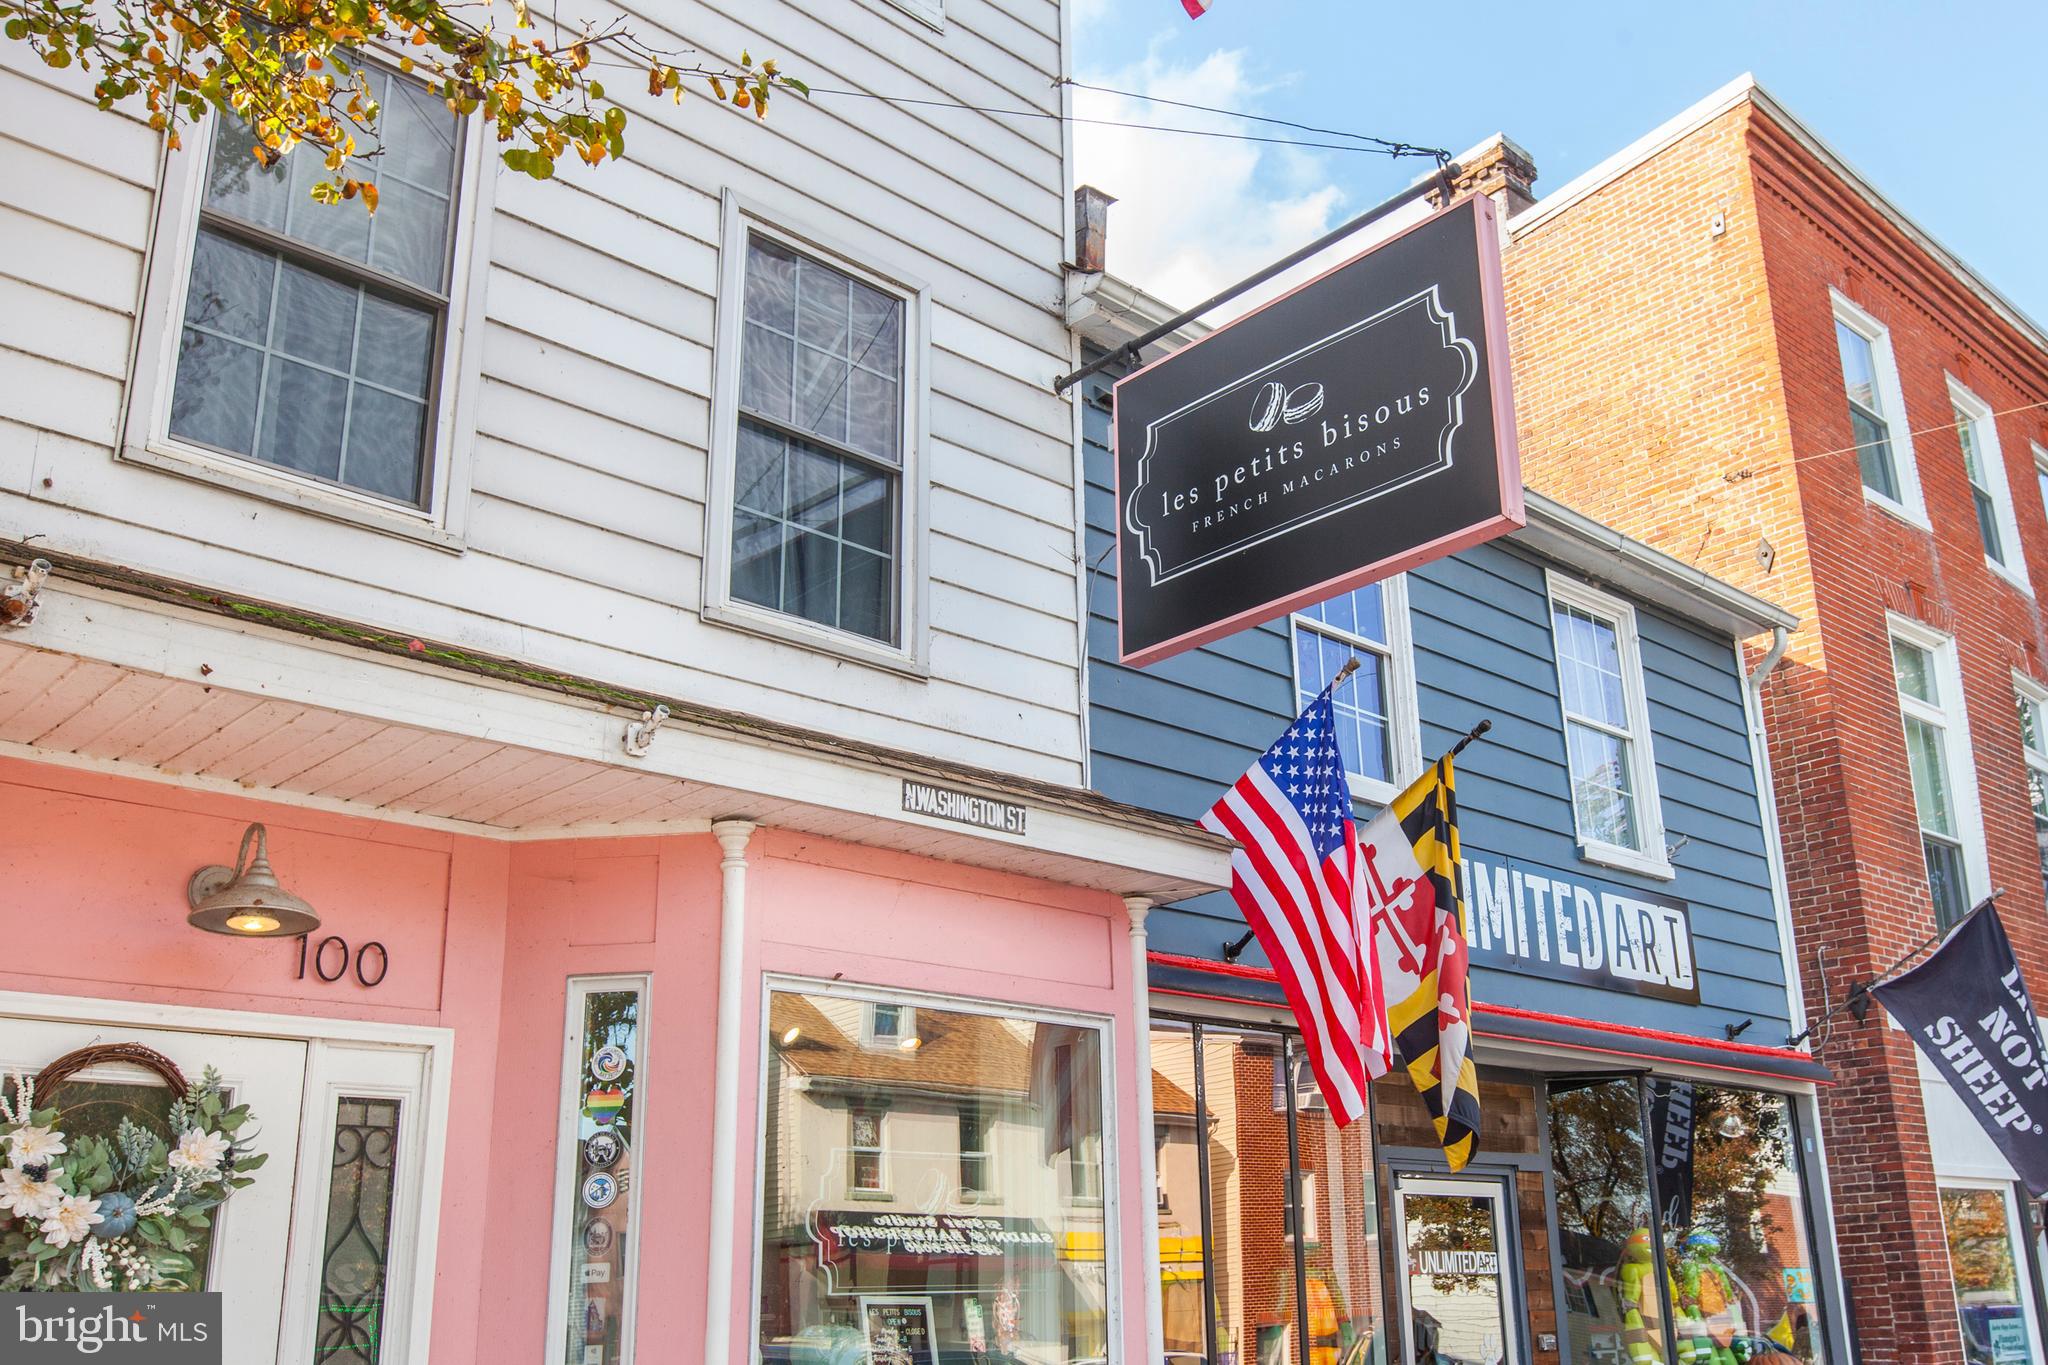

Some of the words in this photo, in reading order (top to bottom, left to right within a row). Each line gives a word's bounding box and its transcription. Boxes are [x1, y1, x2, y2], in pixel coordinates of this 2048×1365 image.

[1161, 487, 1199, 517] les
[1214, 441, 1304, 502] petits
[1320, 386, 1430, 447] bisous
[1191, 491, 1268, 533] FRENCH
[1282, 437, 1402, 495] MACARONS
[297, 934, 388, 988] 100
[1978, 1006, 2047, 1091] NOT
[591, 1269, 606, 1278] Pay
